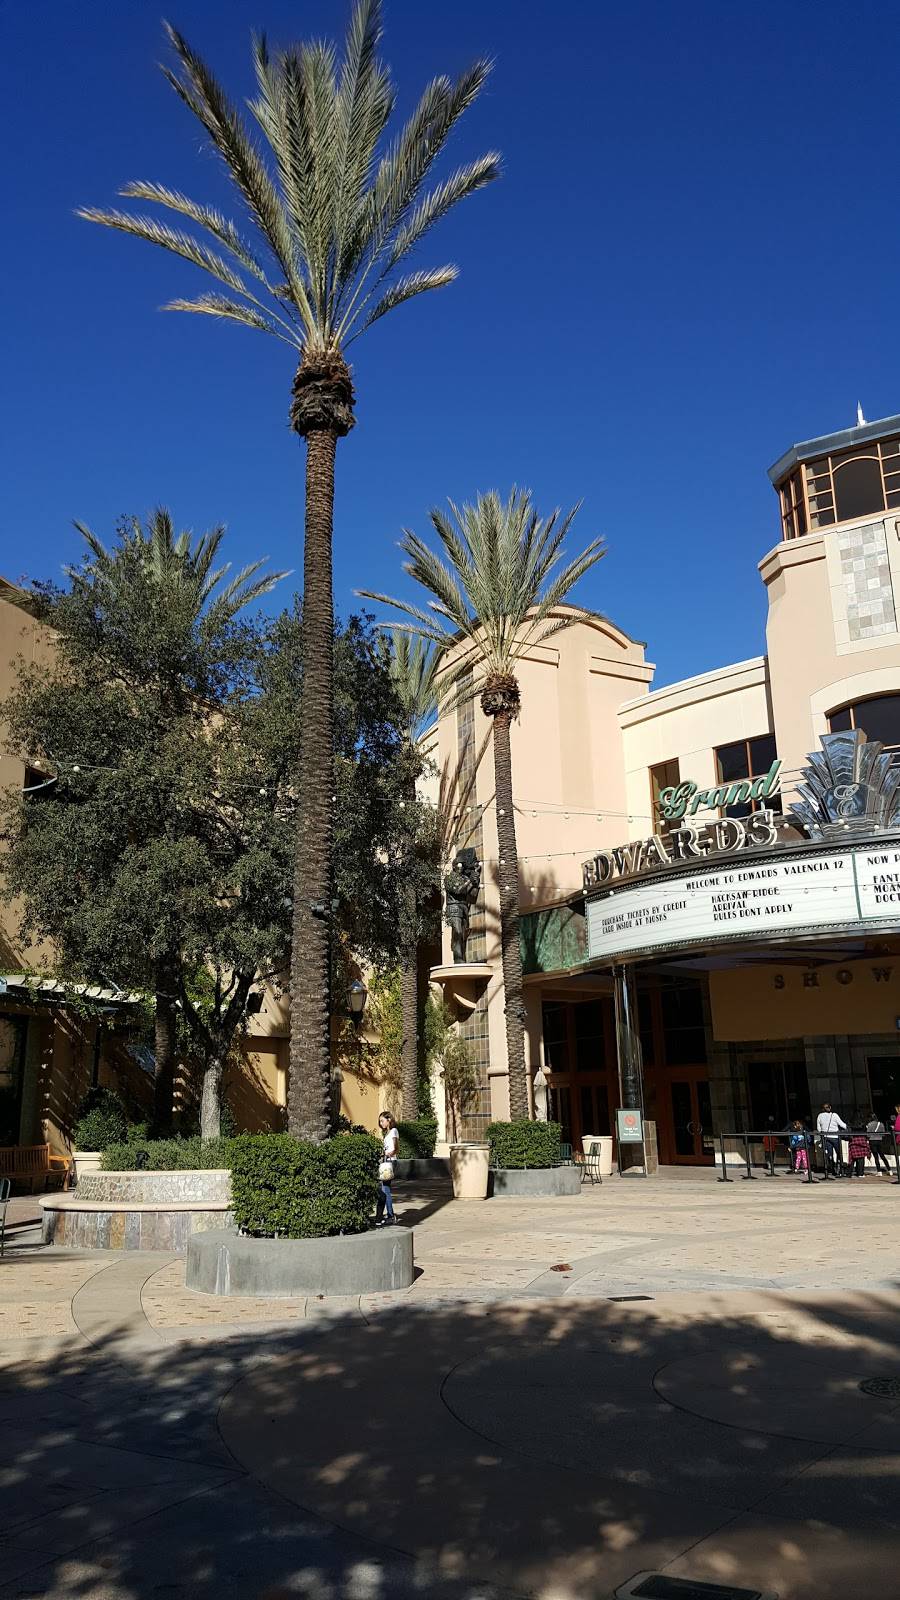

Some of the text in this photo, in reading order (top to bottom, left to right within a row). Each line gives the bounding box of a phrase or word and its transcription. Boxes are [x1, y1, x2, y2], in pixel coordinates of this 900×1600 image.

[659, 759, 783, 819] Grand
[581, 809, 778, 887] EDWARDS
[867, 855, 889, 865] NOW
[686, 860, 844, 890] WELCOME TO EDWARDS VALENCIA 12
[711, 887, 780, 904] HACKSAW RIDGE
[627, 908, 649, 919] TICKETS
[652, 906, 660, 914] BY
[663, 900, 687, 912] CREDIT
[712, 900, 746, 912] ARRIVAL
[713, 903, 793, 921] RULES DONT APPLY
[616, 920, 633, 931] INSIDE
[635, 918, 642, 926] AT
[645, 913, 667, 924] KIOSKS
